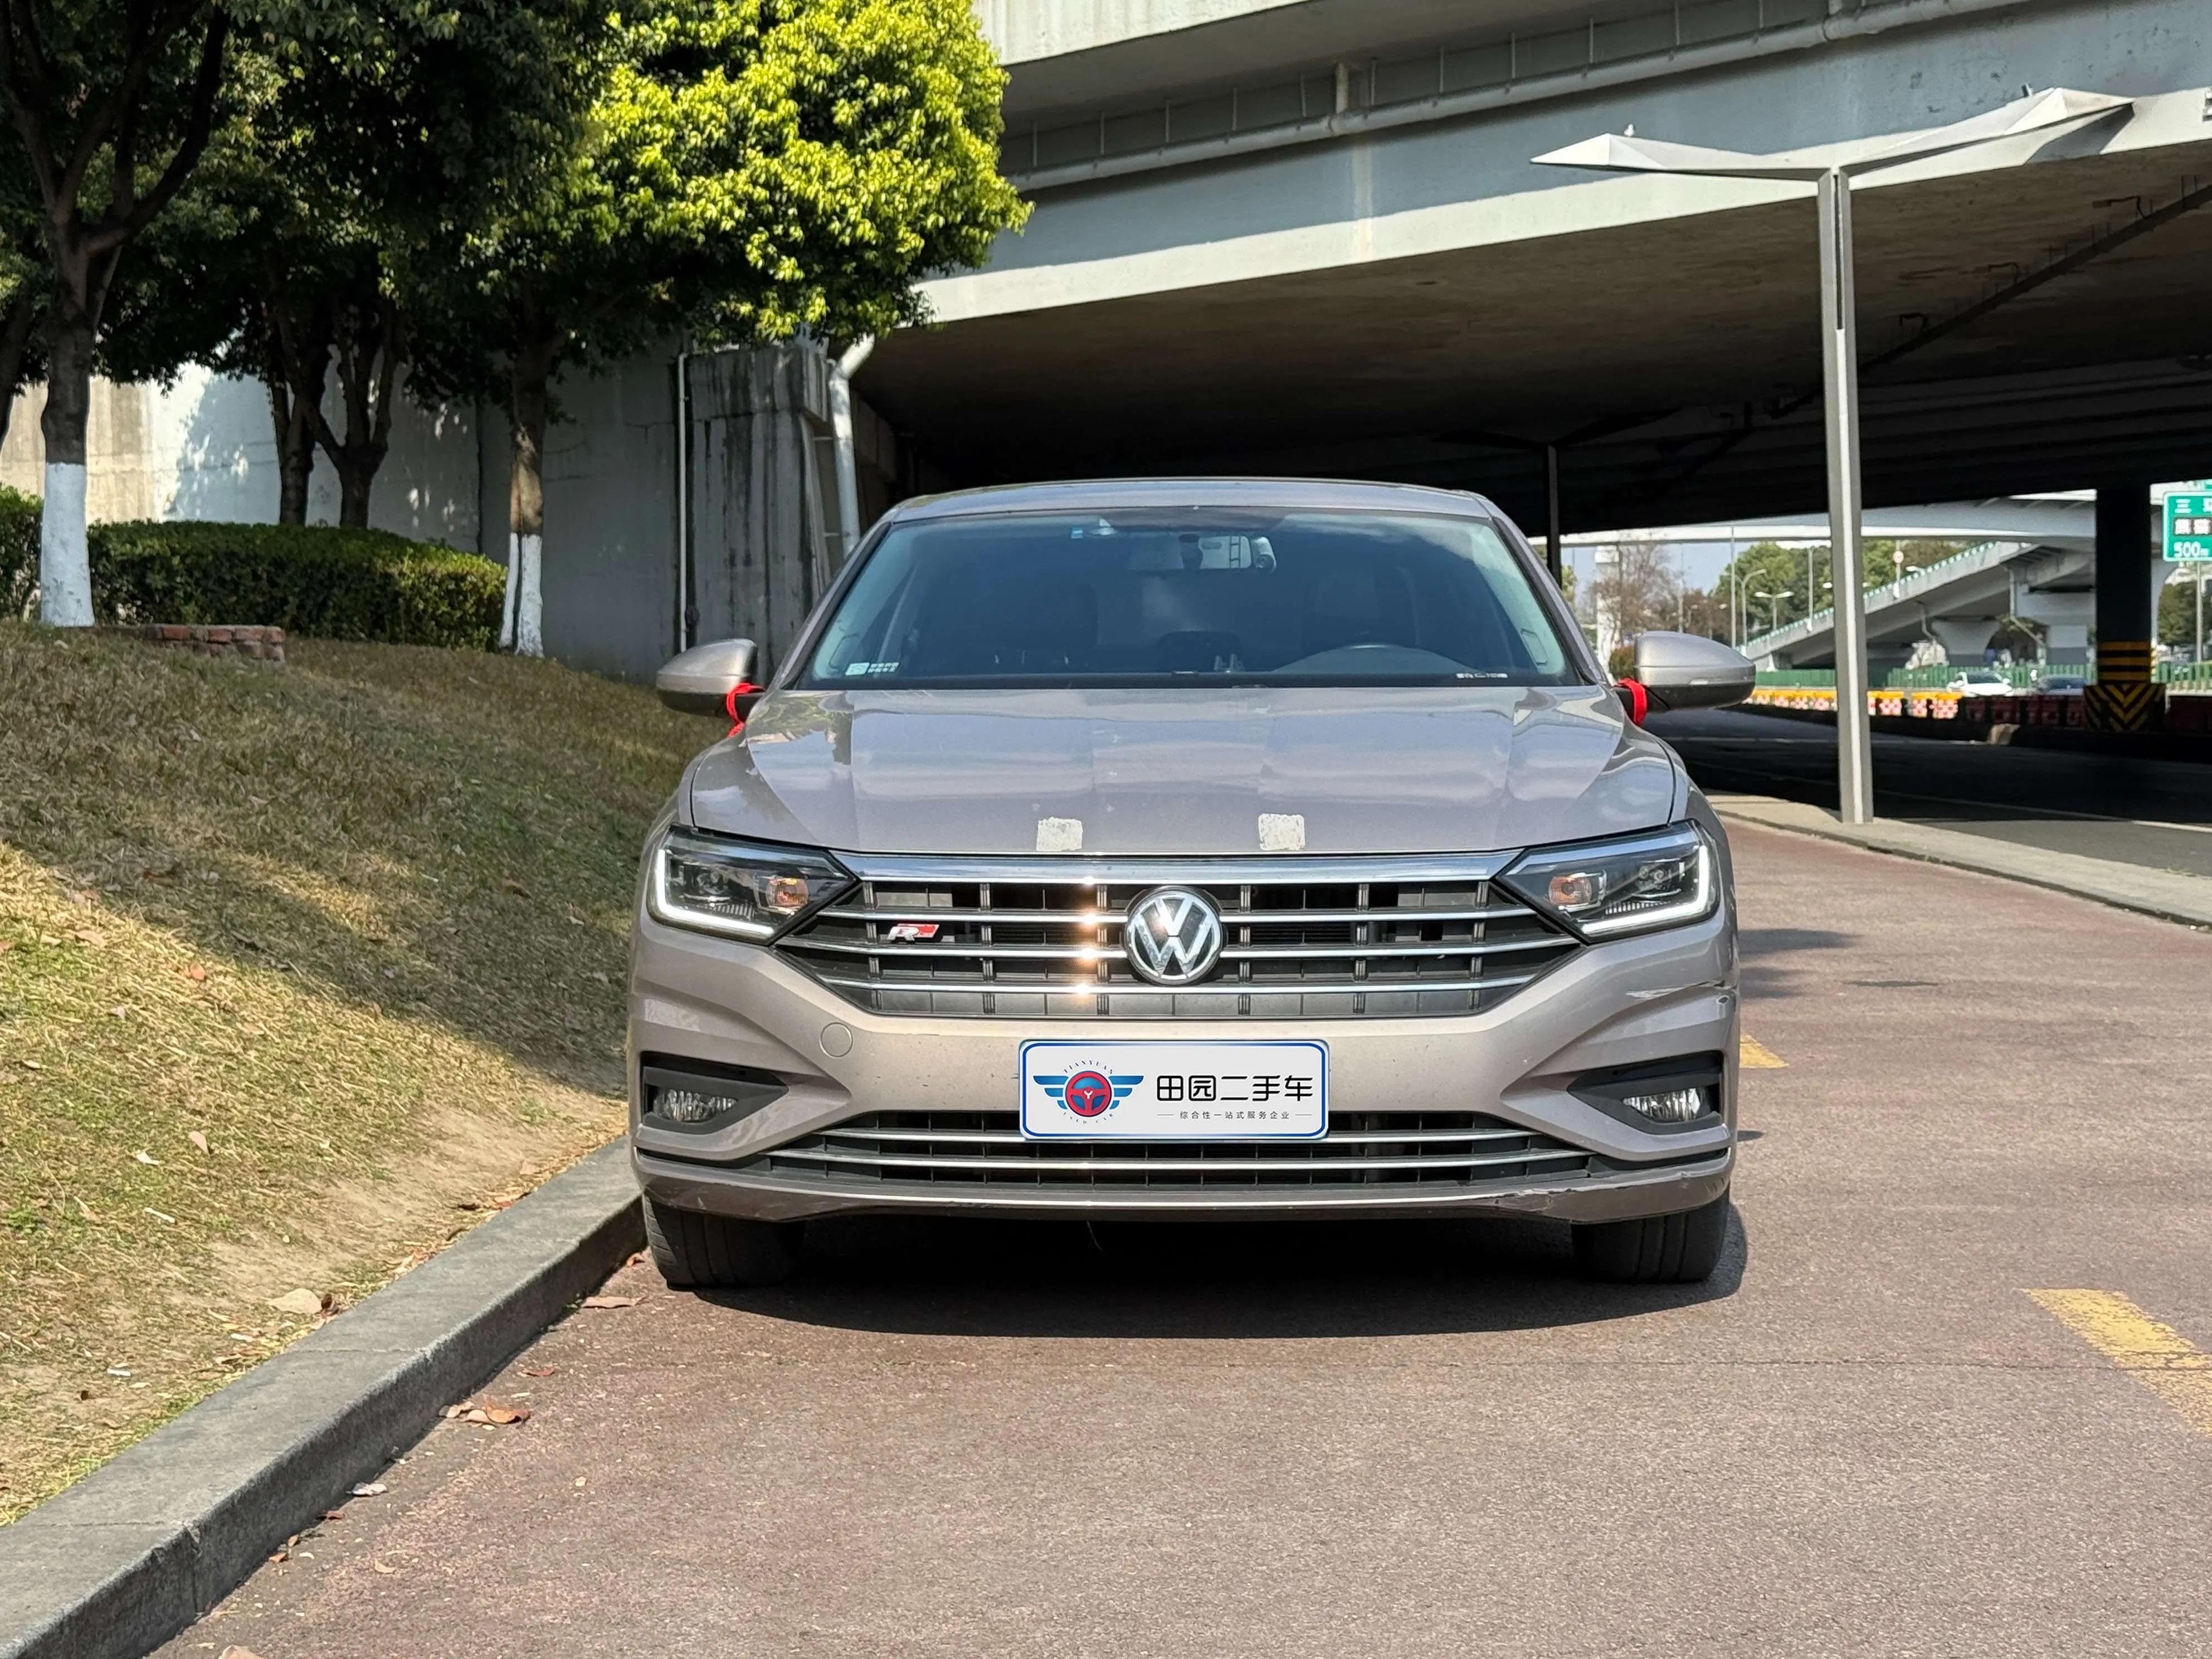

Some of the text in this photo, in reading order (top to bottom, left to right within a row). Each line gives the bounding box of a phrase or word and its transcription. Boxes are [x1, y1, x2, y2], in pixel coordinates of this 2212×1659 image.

[1157, 1075, 1313, 1101] 田园二手车
[1179, 1110, 1290, 1120] 综合性一站式服务企业
